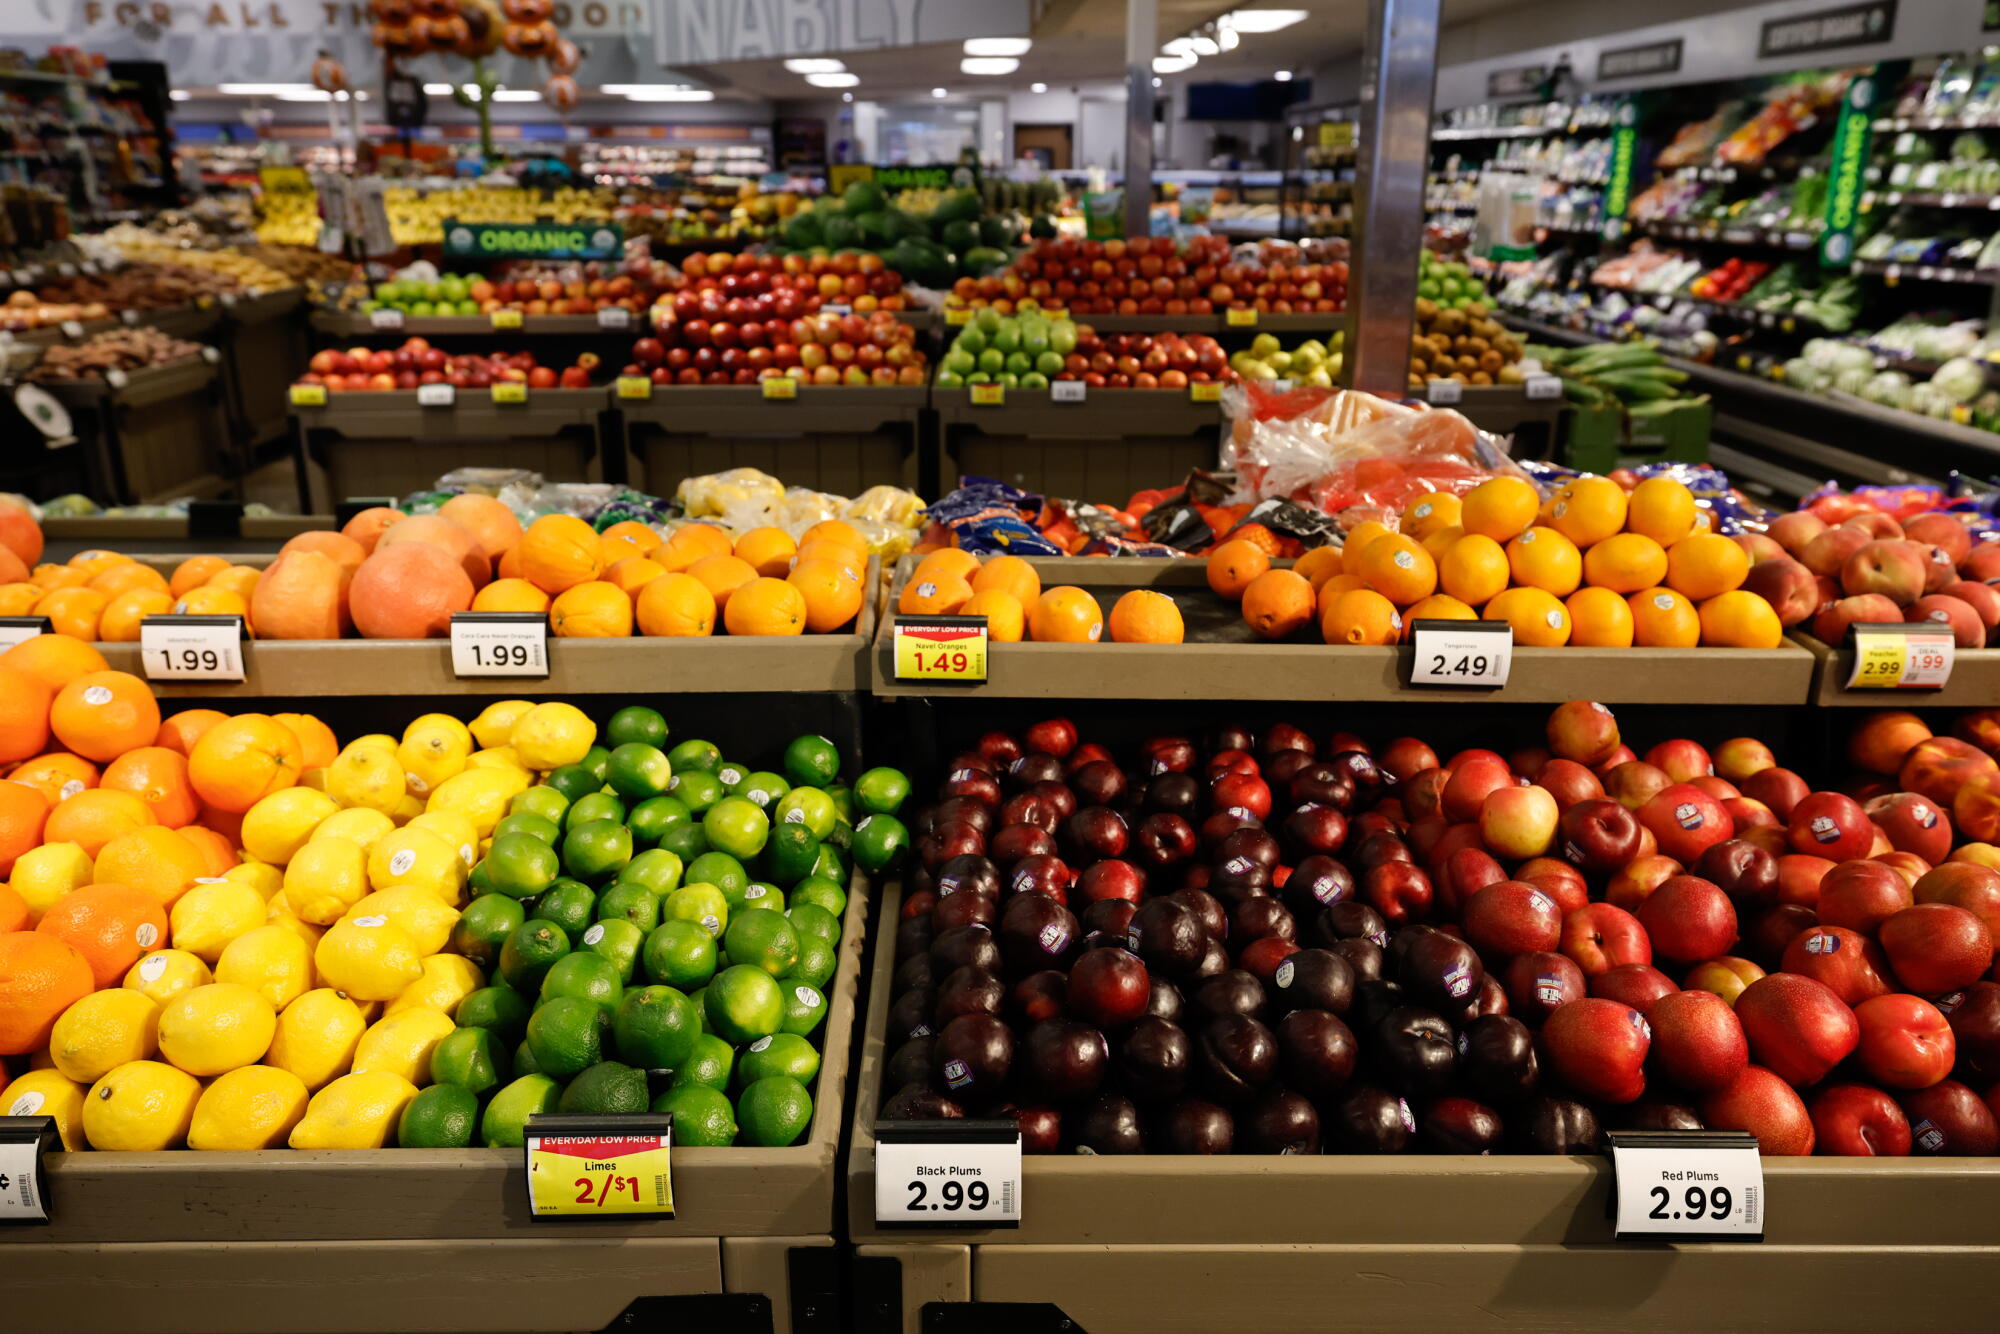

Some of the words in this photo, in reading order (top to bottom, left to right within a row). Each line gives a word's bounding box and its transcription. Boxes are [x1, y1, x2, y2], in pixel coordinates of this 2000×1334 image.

[83, 2, 171, 27] FOR
[205, 2, 288, 27] ALL
[1831, 113, 1868, 230] ORGANIC
[479, 229, 586, 251] ORGANIC
[161, 649, 218, 671] 1.99
[472, 645, 527, 666] 1.99
[914, 652, 967, 672] 1.49
[1430, 655, 1487, 676] 2.49
[1912, 655, 1944, 669] 1.99
[1864, 662, 1900, 674] 2.99
[544, 1136, 597, 1145] EVERYDAY
[600, 1136, 624, 1144] LOW
[585, 1161, 616, 1171] Limes
[916, 1166, 946, 1176] Black
[949, 1166, 982, 1176] Plums
[1662, 1171, 1683, 1181] Red
[1686, 1171, 1719, 1181] Plums
[575, 1173, 640, 1207] 2/$1
[907, 1180, 989, 1211] 2.99
[1649, 1186, 1732, 1220] 2.99
